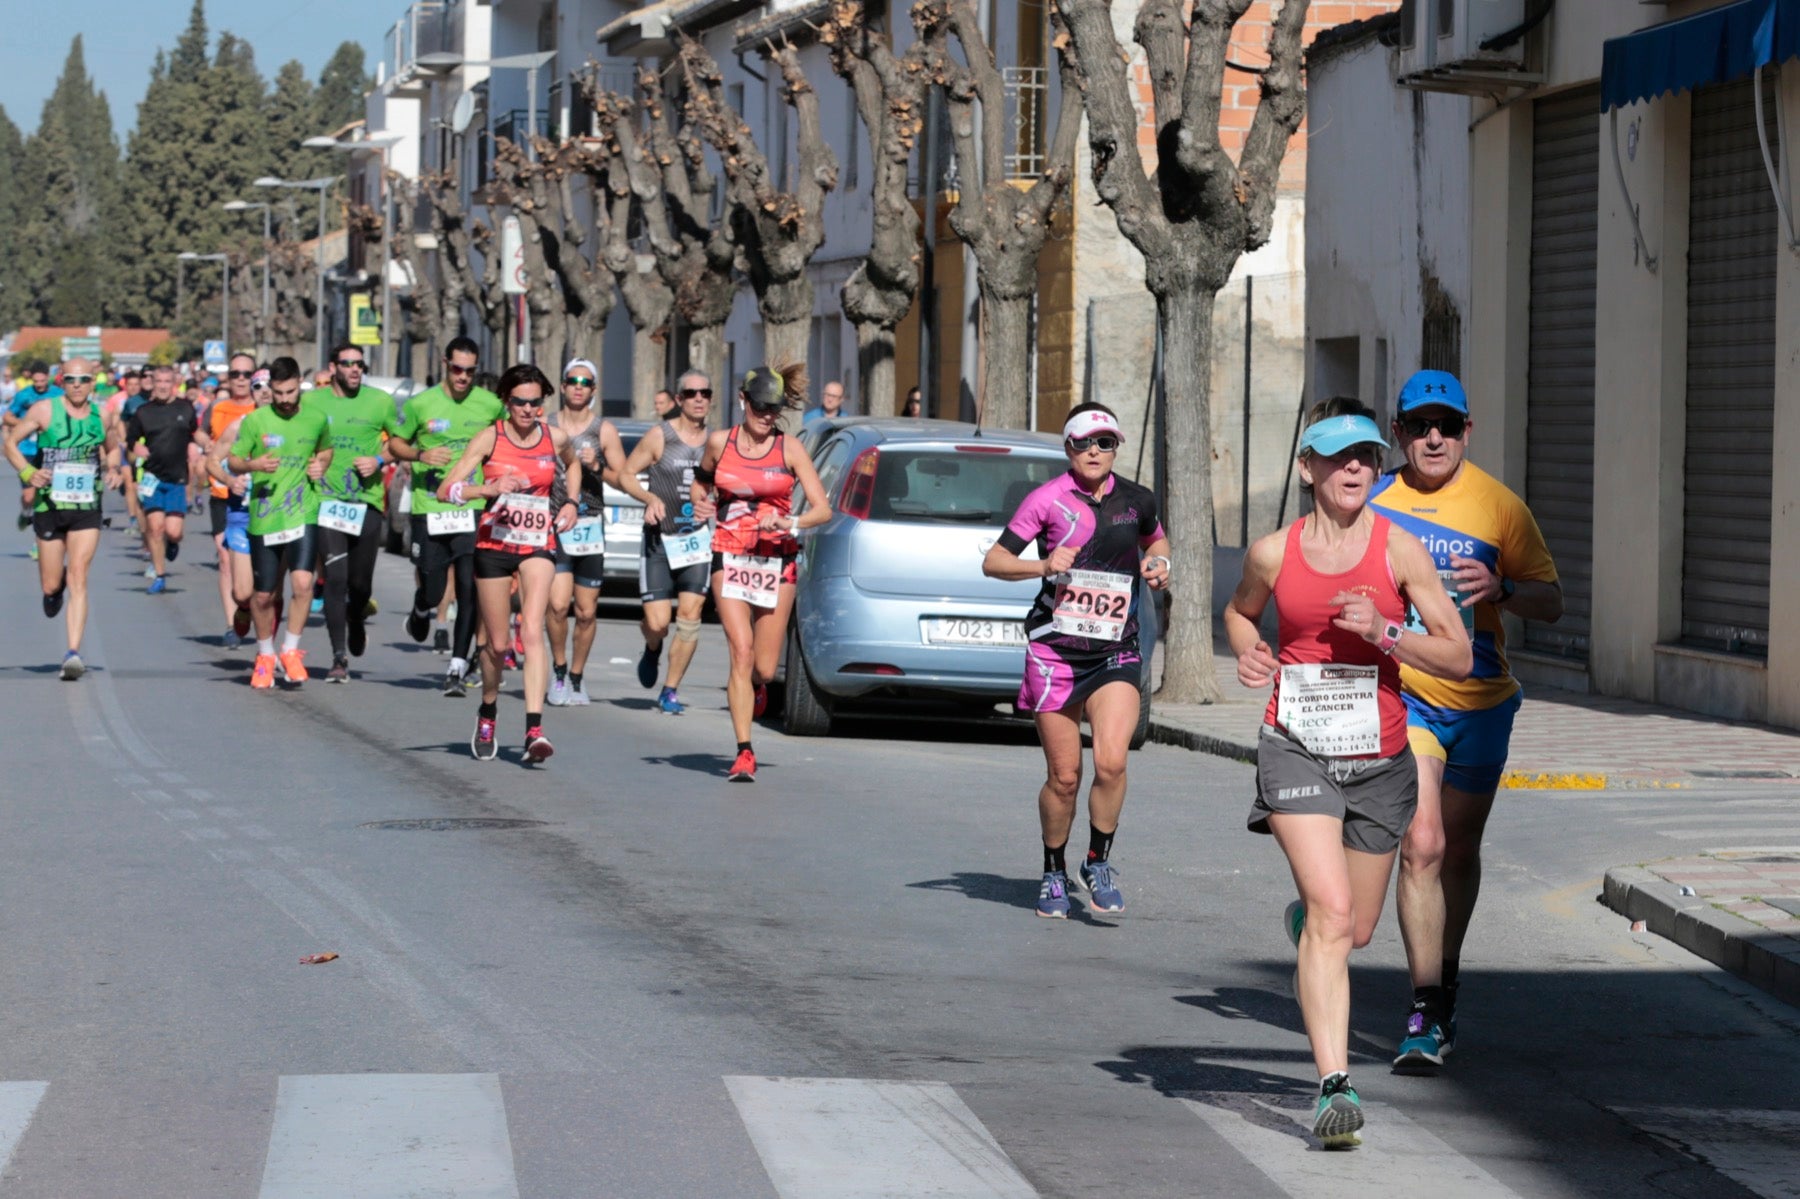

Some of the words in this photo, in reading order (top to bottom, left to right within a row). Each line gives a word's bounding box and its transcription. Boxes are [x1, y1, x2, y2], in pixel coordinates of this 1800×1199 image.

[66, 476, 85, 490] 85
[328, 504, 357, 521] 430
[496, 508, 546, 529] 2089
[573, 526, 591, 542] 57
[728, 567, 777, 591] 2092
[1060, 588, 1127, 619] 2062
[946, 620, 994, 638] 7023
[1298, 693, 1330, 703] CORRO
[1332, 692, 1374, 700] CONTRA
[1315, 703, 1355, 712] CANCER
[1298, 717, 1333, 728] aecc
